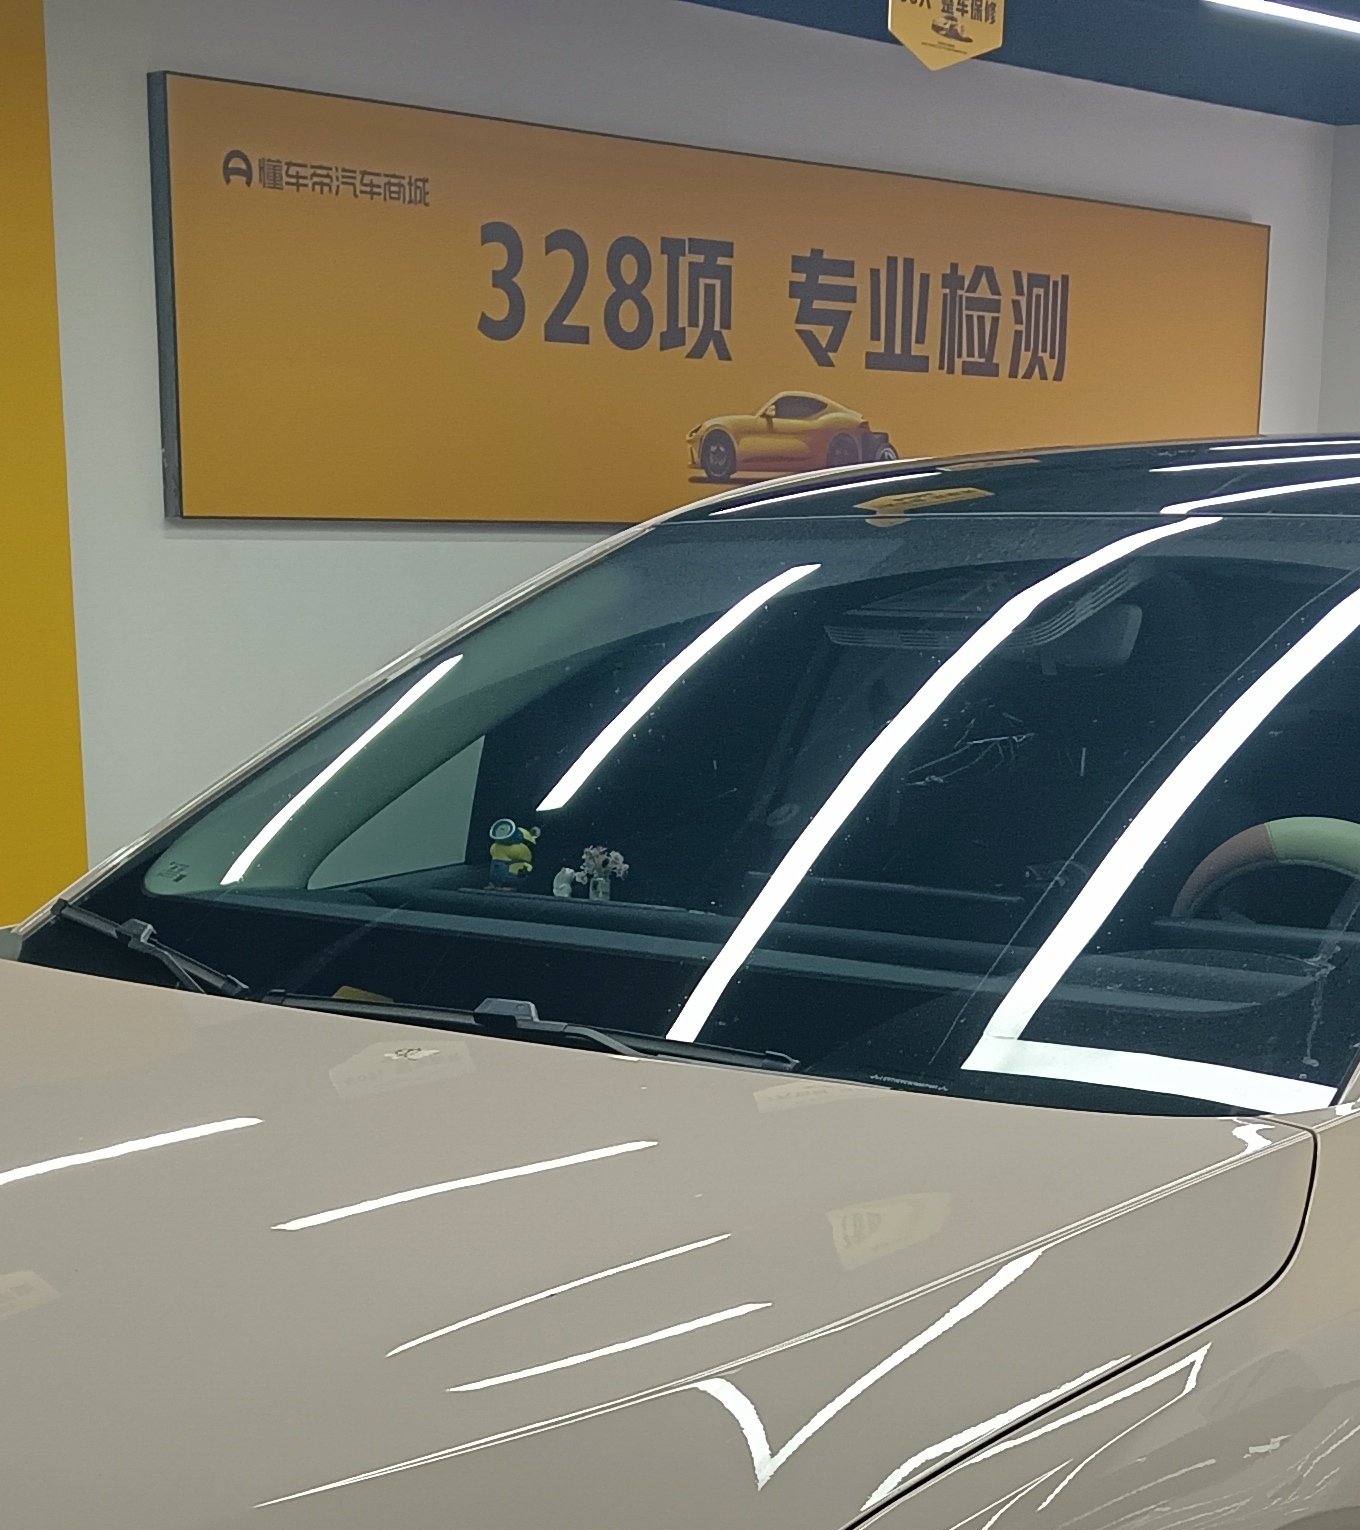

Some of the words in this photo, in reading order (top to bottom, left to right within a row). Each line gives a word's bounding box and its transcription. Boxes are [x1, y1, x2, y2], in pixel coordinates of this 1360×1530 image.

[258, 157, 430, 207] 懂车帝汽车商城
[477, 221, 736, 363] 328项
[789, 248, 1070, 383] 专业检测
